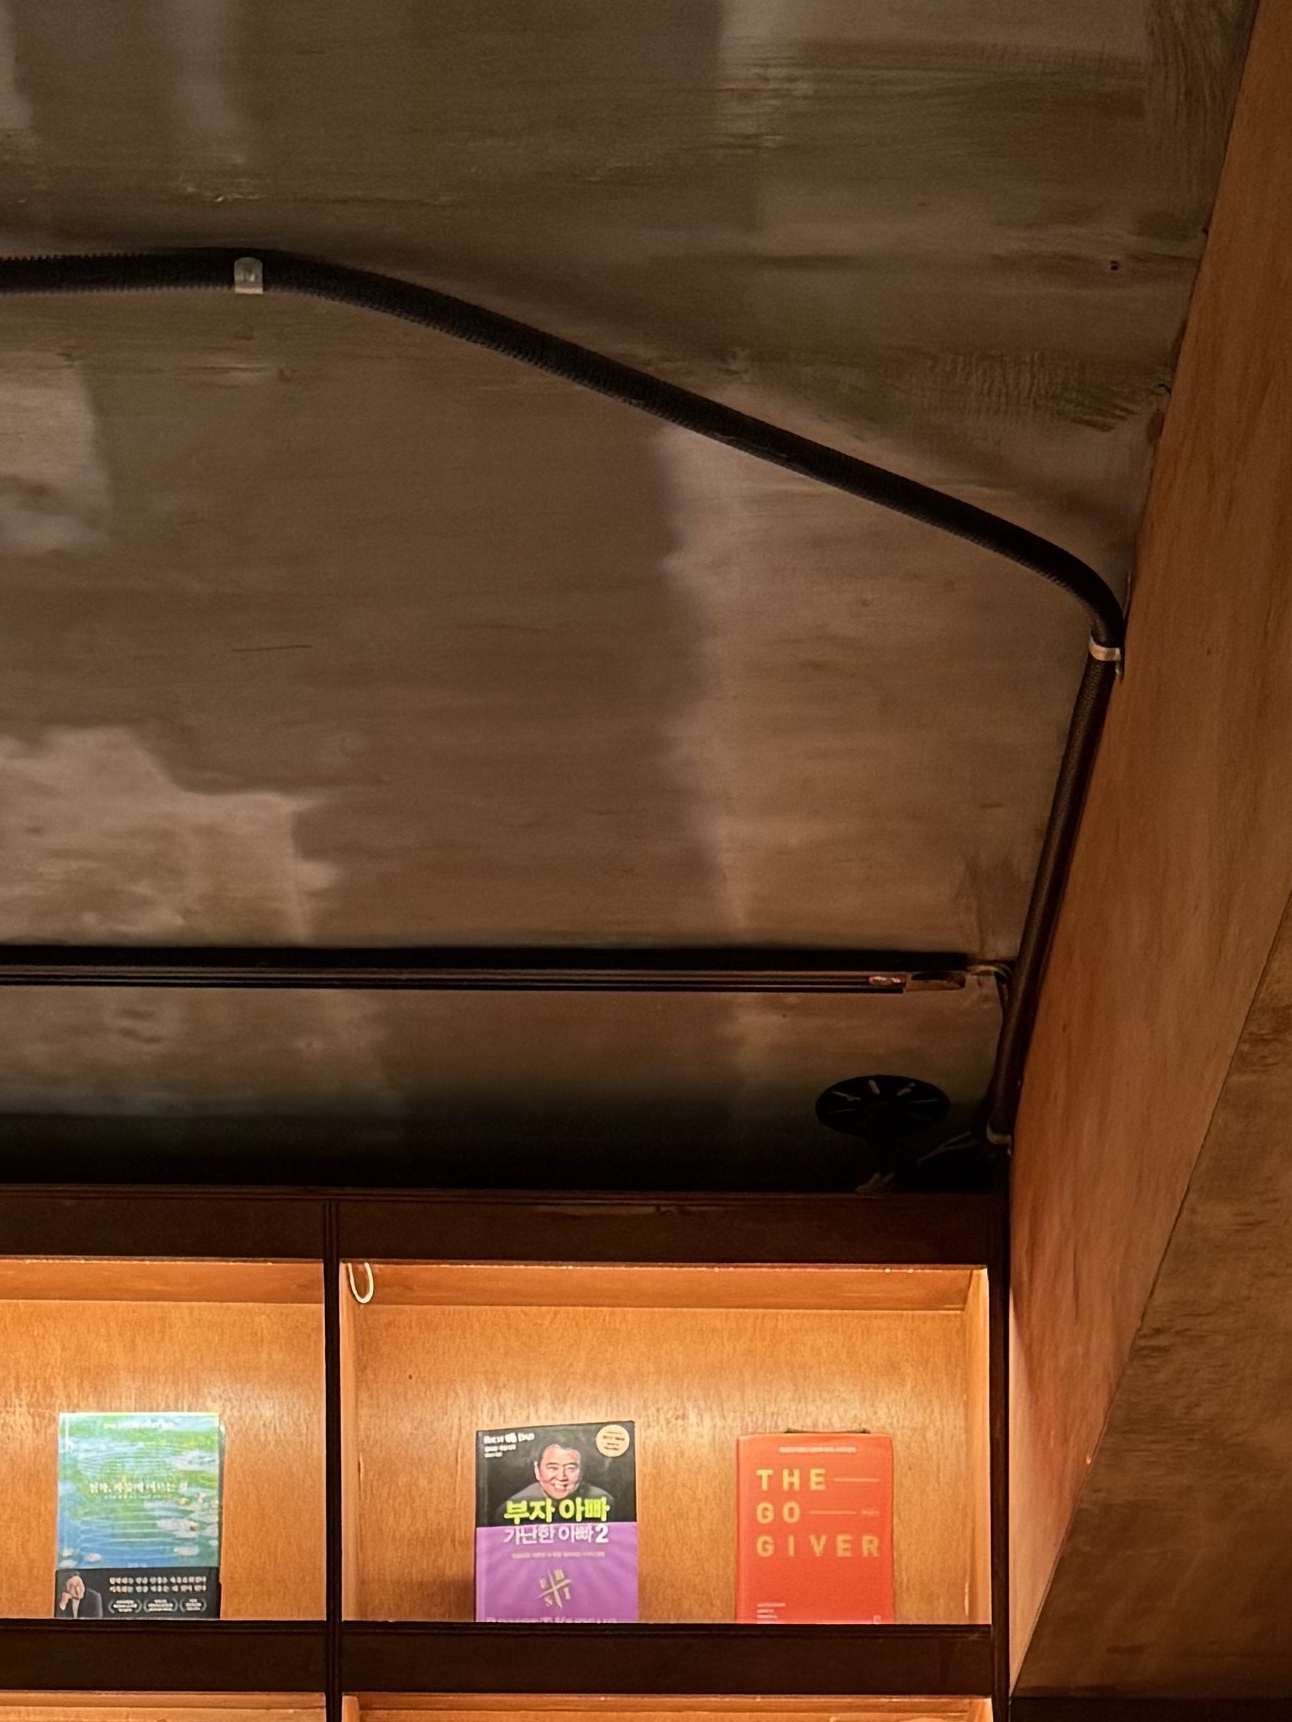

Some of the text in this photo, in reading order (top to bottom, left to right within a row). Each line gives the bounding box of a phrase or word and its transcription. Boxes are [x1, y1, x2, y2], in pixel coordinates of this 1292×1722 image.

[756, 1468, 826, 1491] THE
[503, 1496, 611, 1525] 부자 아빠
[756, 1501, 801, 1524] GO
[503, 1525, 555, 1545] 가난한
[756, 1534, 880, 1558] GIVER
